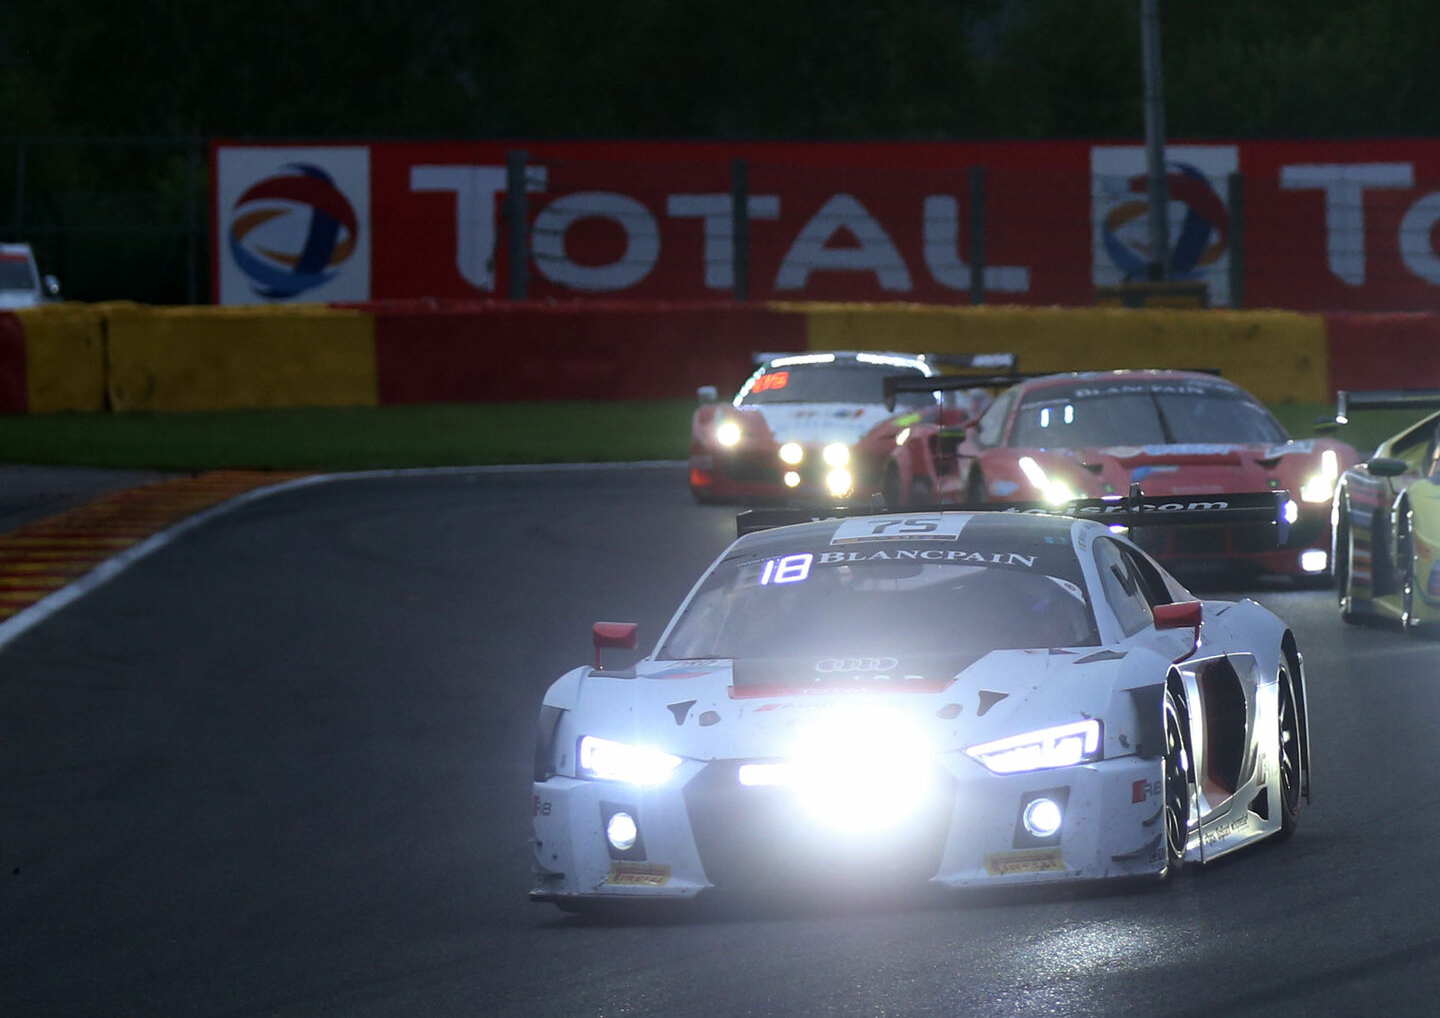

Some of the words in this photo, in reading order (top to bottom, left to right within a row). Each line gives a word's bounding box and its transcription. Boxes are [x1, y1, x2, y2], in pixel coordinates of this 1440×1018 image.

[410, 164, 1030, 293] TOTAL
[867, 517, 940, 535] 75
[760, 552, 814, 586] 18
[816, 549, 1039, 568] BLANCPAIN
